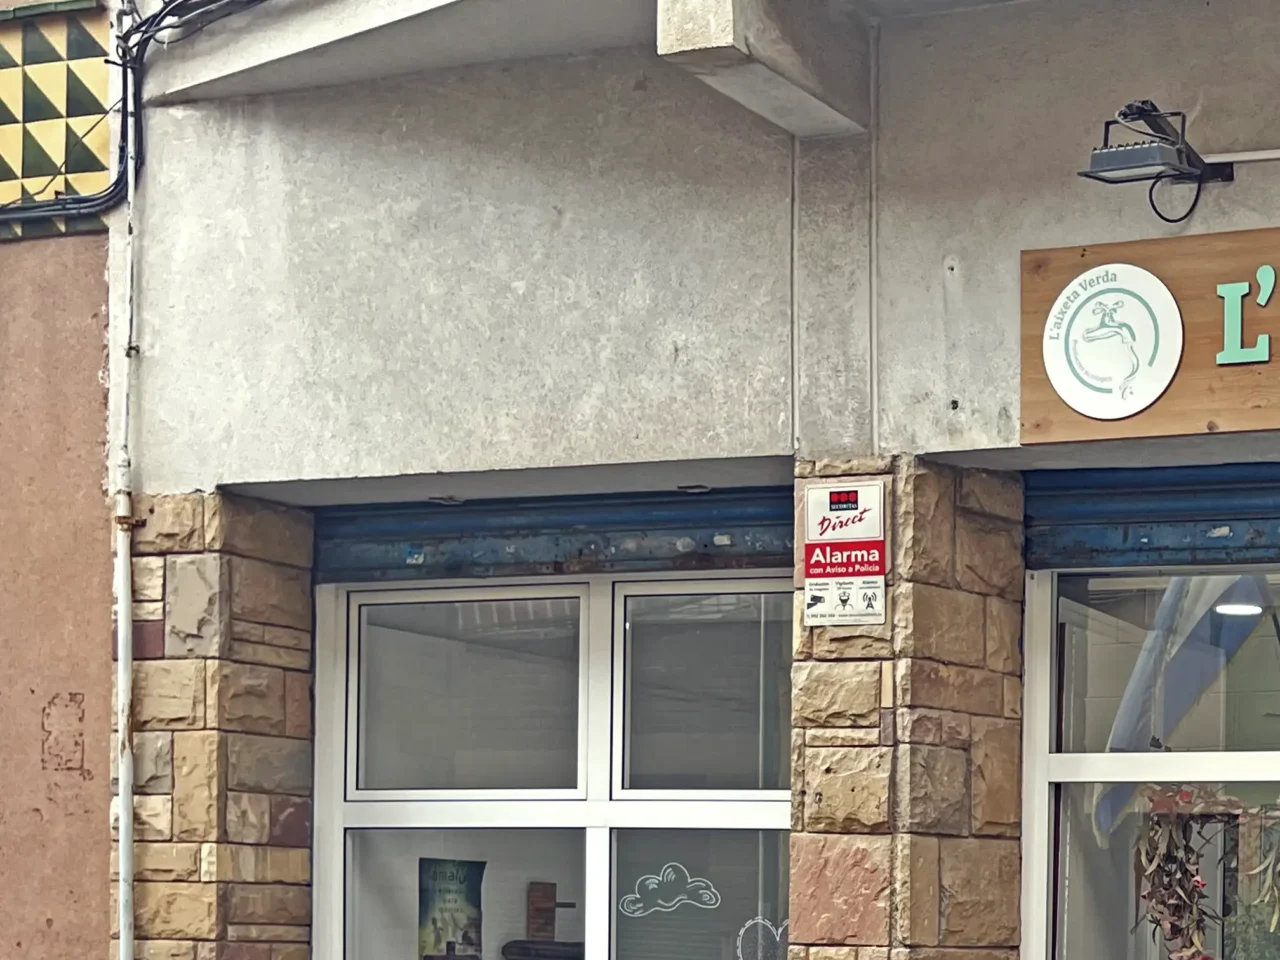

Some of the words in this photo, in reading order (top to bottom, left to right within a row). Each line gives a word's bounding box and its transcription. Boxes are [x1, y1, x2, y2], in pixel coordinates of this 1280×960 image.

[1078, 270, 1118, 292] Verda
[817, 508, 872, 537] Direct
[810, 546, 880, 565] Alarma
[809, 567, 824, 575] con
[825, 565, 847, 574] Aviso
